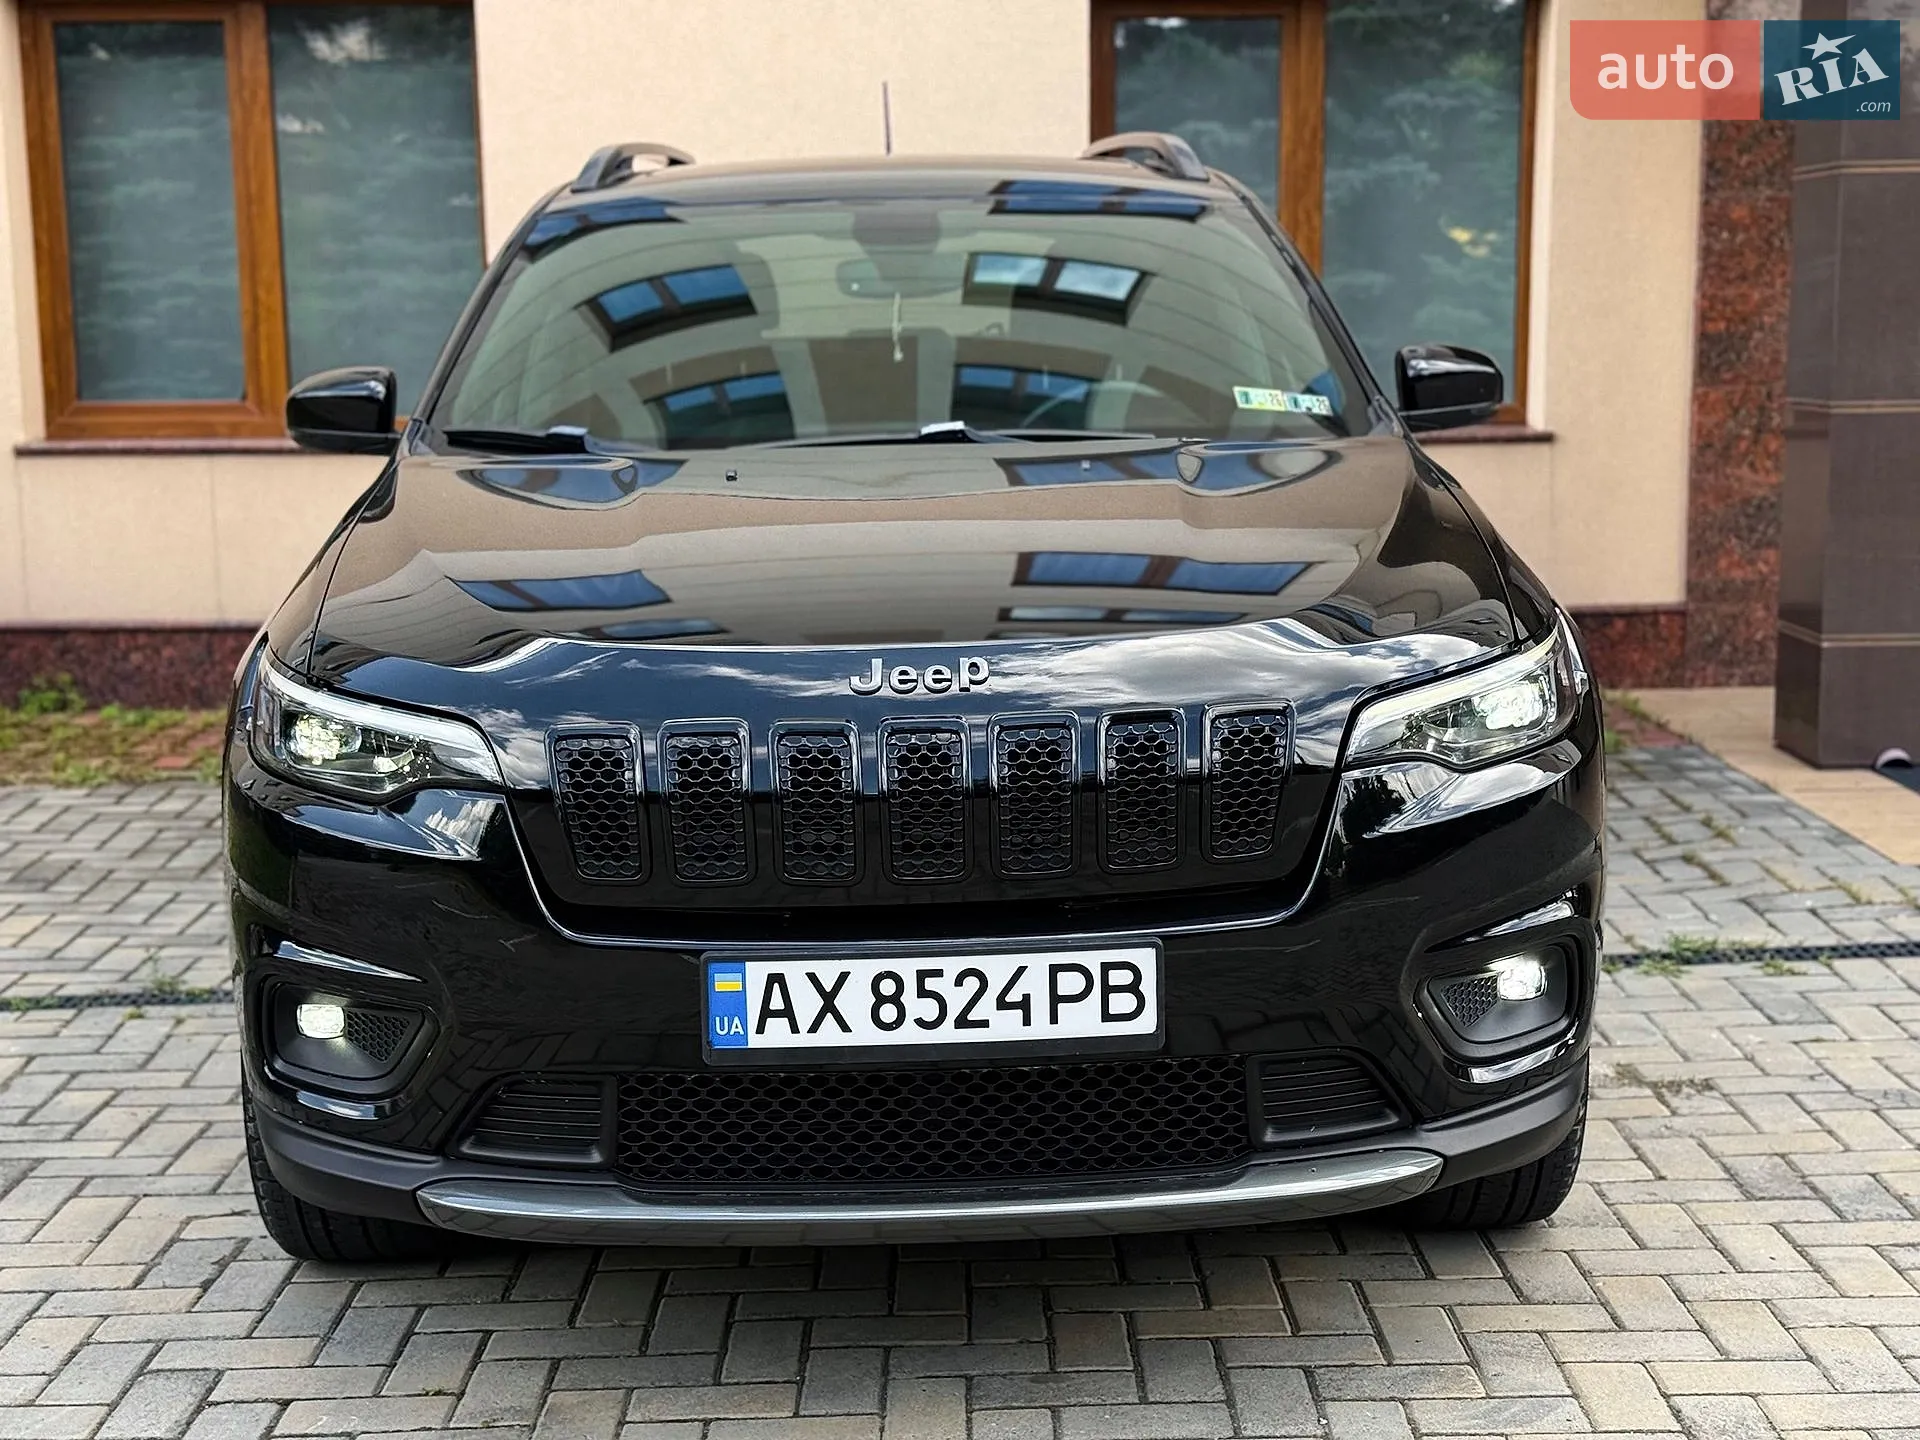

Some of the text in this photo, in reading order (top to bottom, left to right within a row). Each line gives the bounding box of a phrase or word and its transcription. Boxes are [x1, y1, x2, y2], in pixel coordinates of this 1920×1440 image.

[849, 656, 990, 696] Jeep
[754, 960, 1147, 1036] AX 8524 PB
[714, 1015, 745, 1037] UA
